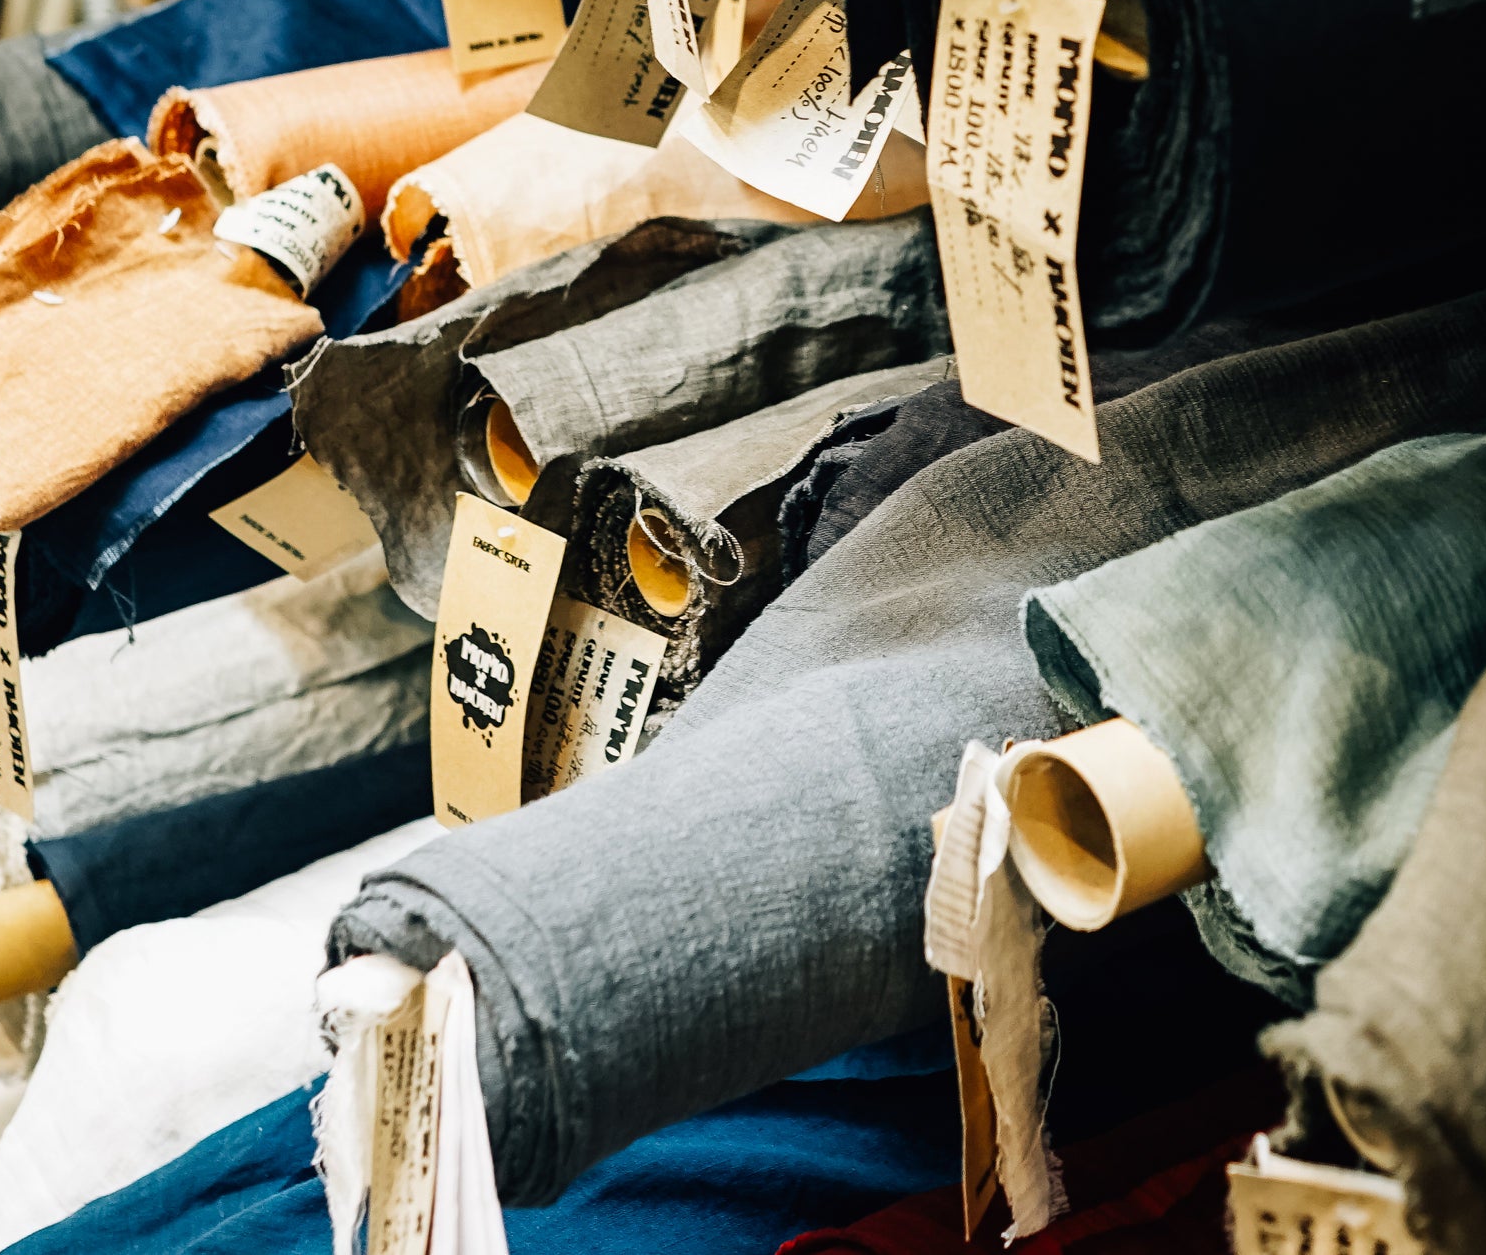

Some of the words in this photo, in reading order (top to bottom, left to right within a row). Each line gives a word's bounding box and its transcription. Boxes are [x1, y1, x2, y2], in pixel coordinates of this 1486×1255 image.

[966, 99, 985, 148] 100
[1049, 38, 1081, 178] MOMO
[459, 635, 510, 685] MOMO
[567, 639, 596, 709] QUALITY
[595, 651, 615, 699] NAME
[538, 684, 567, 726] 100
[605, 659, 650, 763] MOMO
